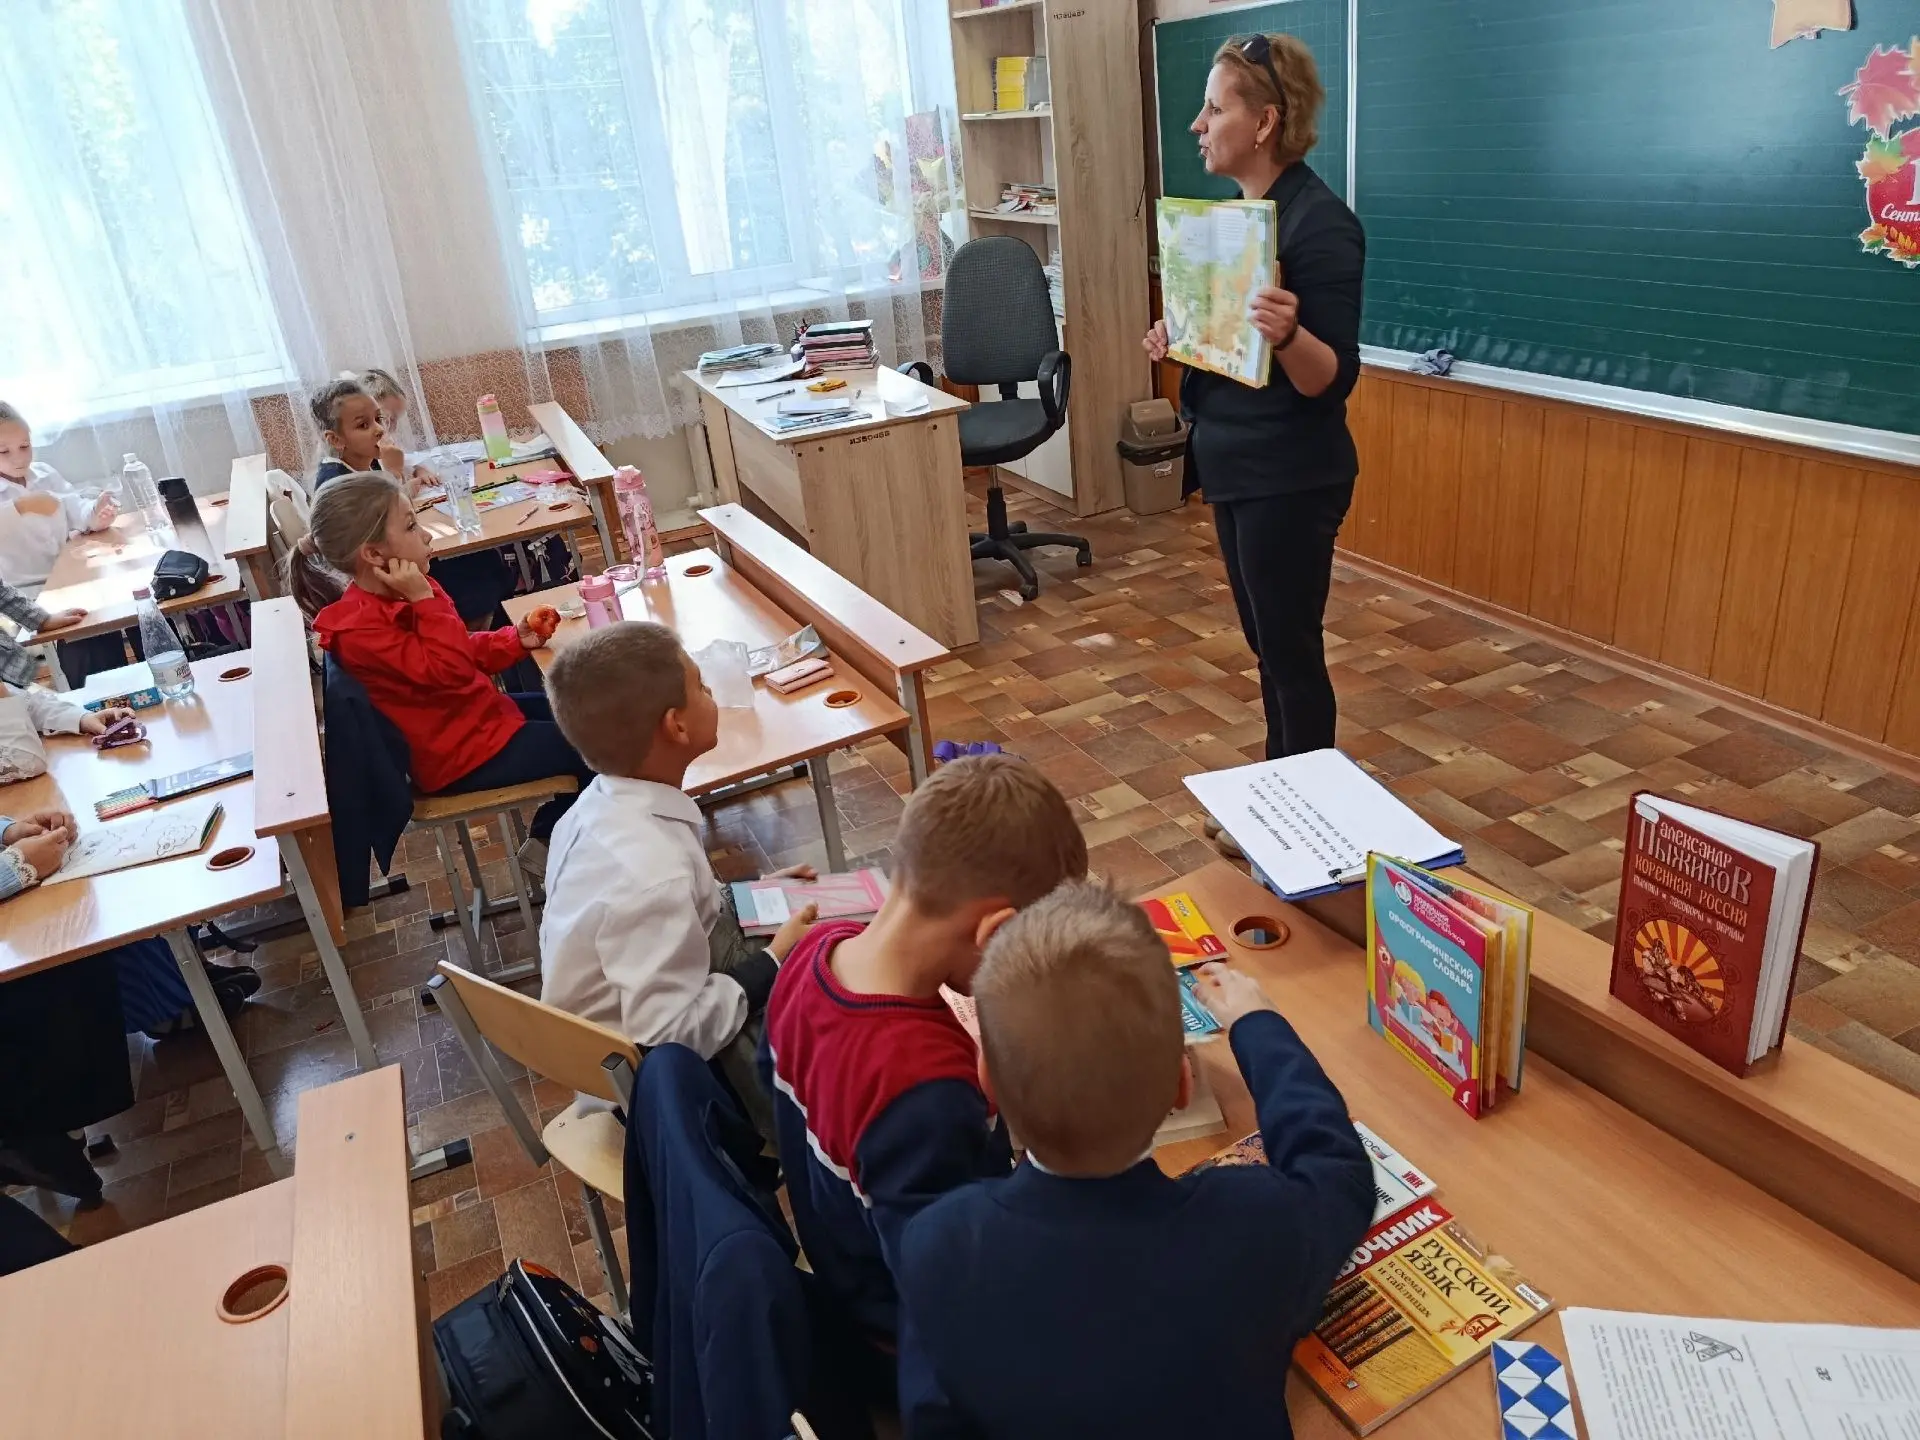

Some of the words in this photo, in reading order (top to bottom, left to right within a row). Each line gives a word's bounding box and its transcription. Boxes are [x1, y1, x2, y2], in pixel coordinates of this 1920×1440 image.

[1880, 203, 1920, 222] Сент
[1699, 886, 1748, 928] РОССИЯ
[1388, 910, 1474, 983] ОРФОГРАФИЧЕСКИЙ
[1432, 958, 1472, 994] СЛОВАРЬ
[1401, 1170, 1425, 1189] УМК
[1394, 1266, 1429, 1299] схемах
[1402, 1249, 1461, 1298] ЯЗЫК
[1421, 1238, 1513, 1316] РУССКИЙ
[1383, 1275, 1432, 1319] таблицах
